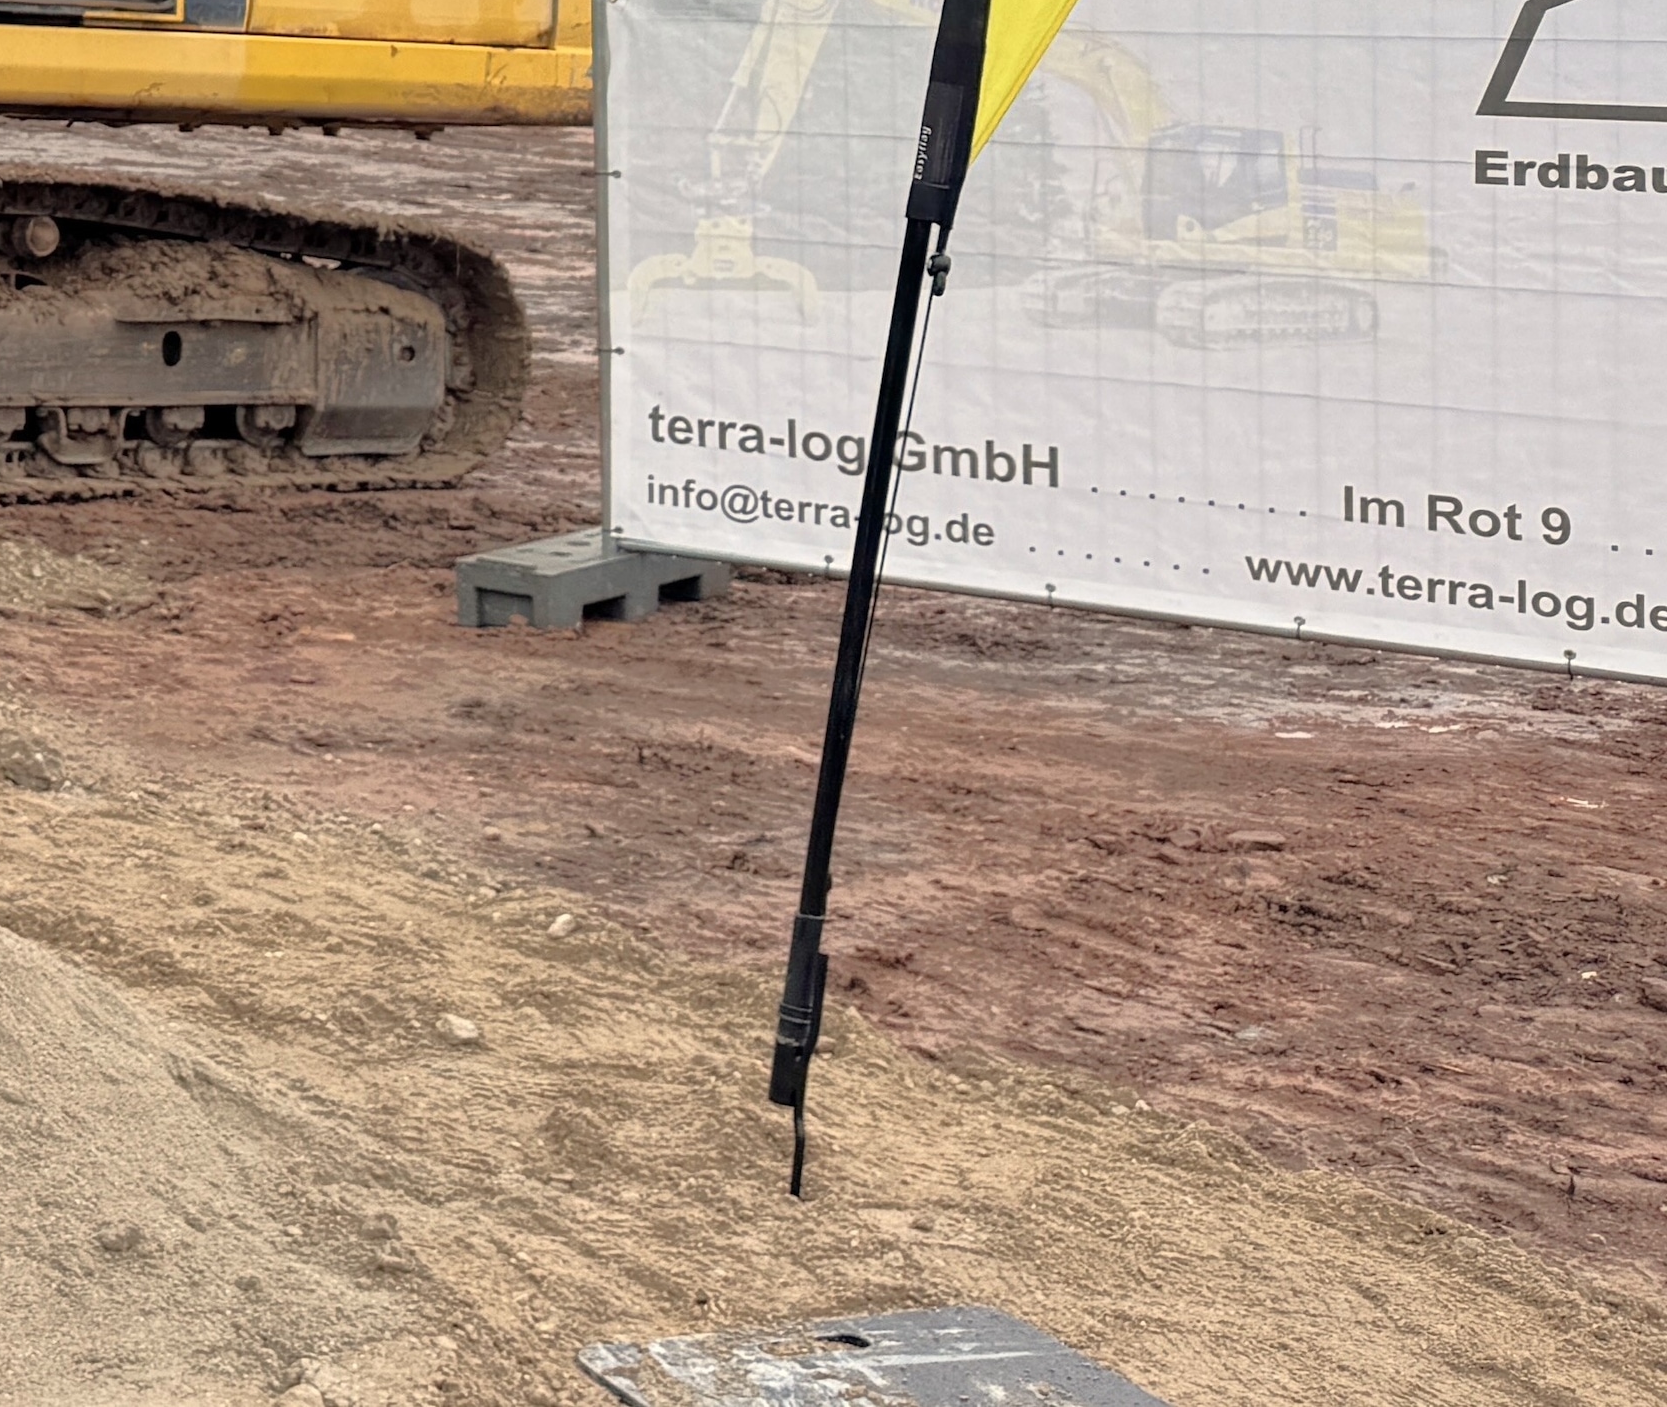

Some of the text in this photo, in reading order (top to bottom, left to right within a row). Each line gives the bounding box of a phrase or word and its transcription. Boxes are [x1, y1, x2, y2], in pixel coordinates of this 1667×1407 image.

[648, 405, 1060, 488] terra-log GmbH
[647, 474, 995, 547] info@terraog.de
[1343, 485, 1571, 546] Im Rot 9
[1245, 556, 1667, 632] www.terra-log.de
